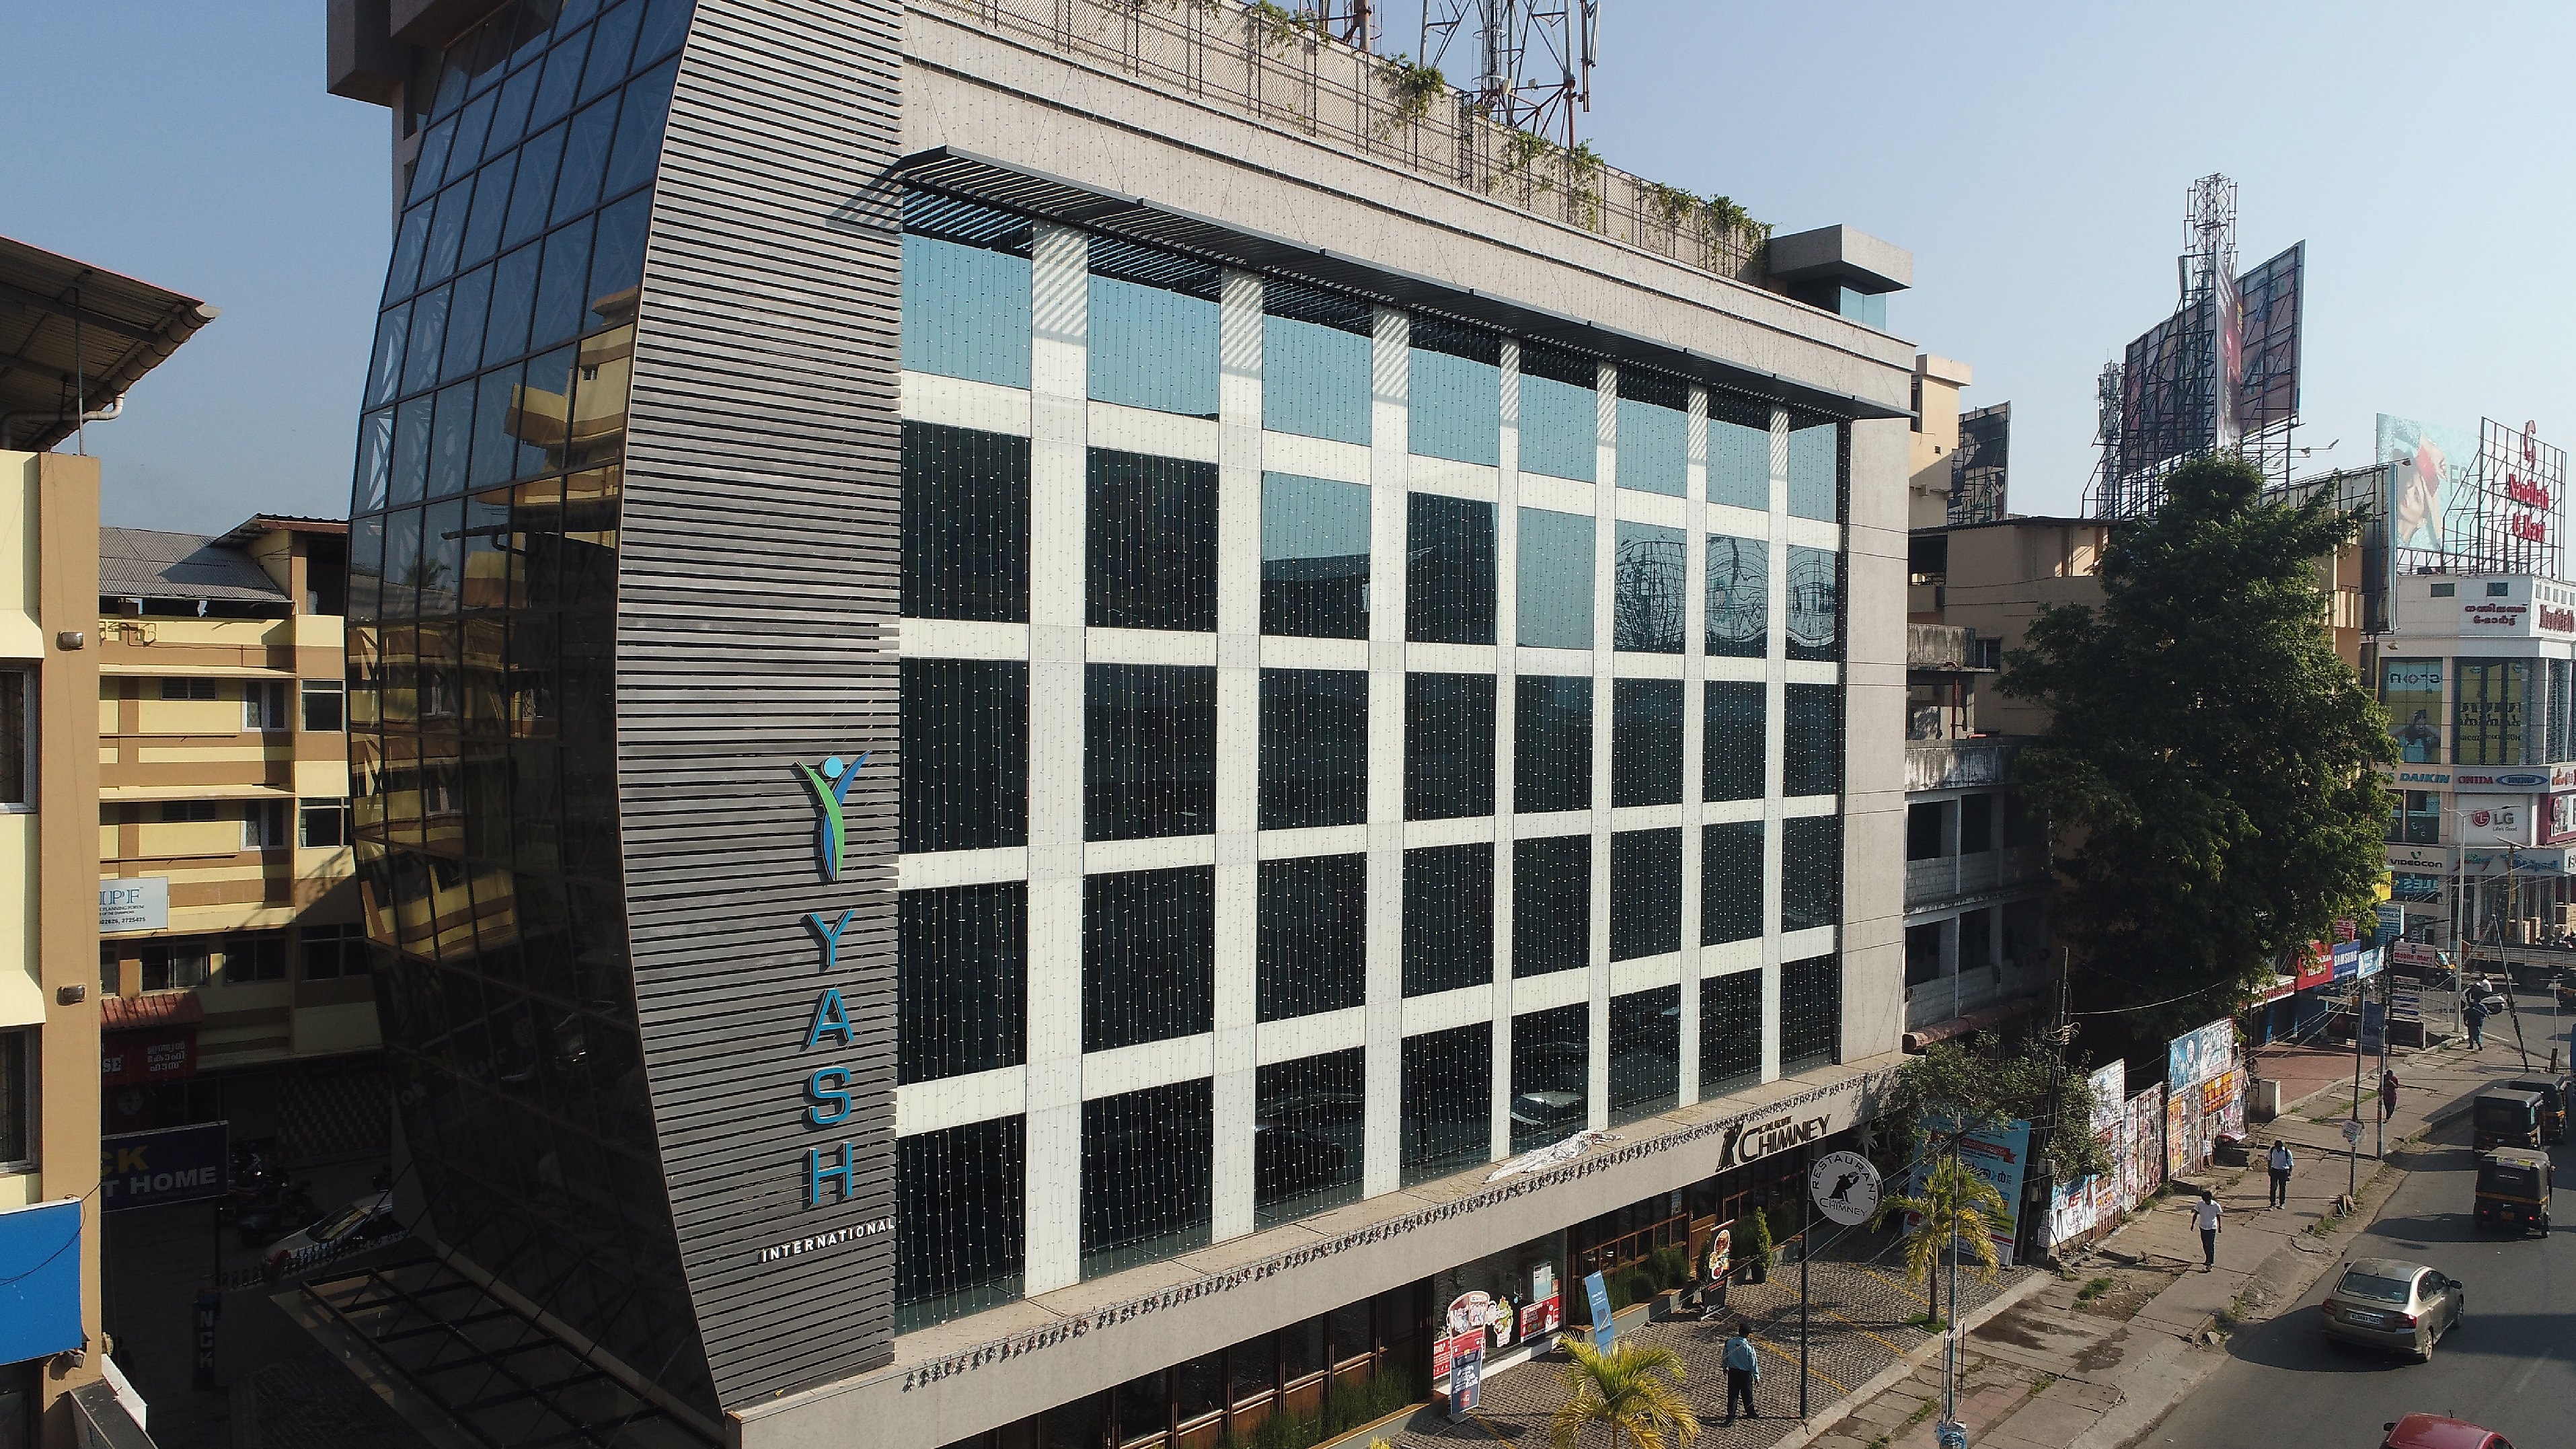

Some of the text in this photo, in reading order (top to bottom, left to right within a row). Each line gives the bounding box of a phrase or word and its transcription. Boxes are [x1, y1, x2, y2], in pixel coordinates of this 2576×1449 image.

[2399, 773, 2451, 784] DAIKIN
[2458, 776, 2494, 784] ONIDA
[2493, 811, 2514, 824] LG
[2334, 951, 2357, 967] SAMSUNG
[805, 909, 856, 1205] YASH
[1739, 1113, 1831, 1163] CHIMNEY
[130, 1166, 217, 1195] HOME
[1813, 1155, 1876, 1205] RESTAURANT
[1819, 1197, 1868, 1216] CHIMNEY
[761, 1218, 895, 1263] INTERNATIONAL
